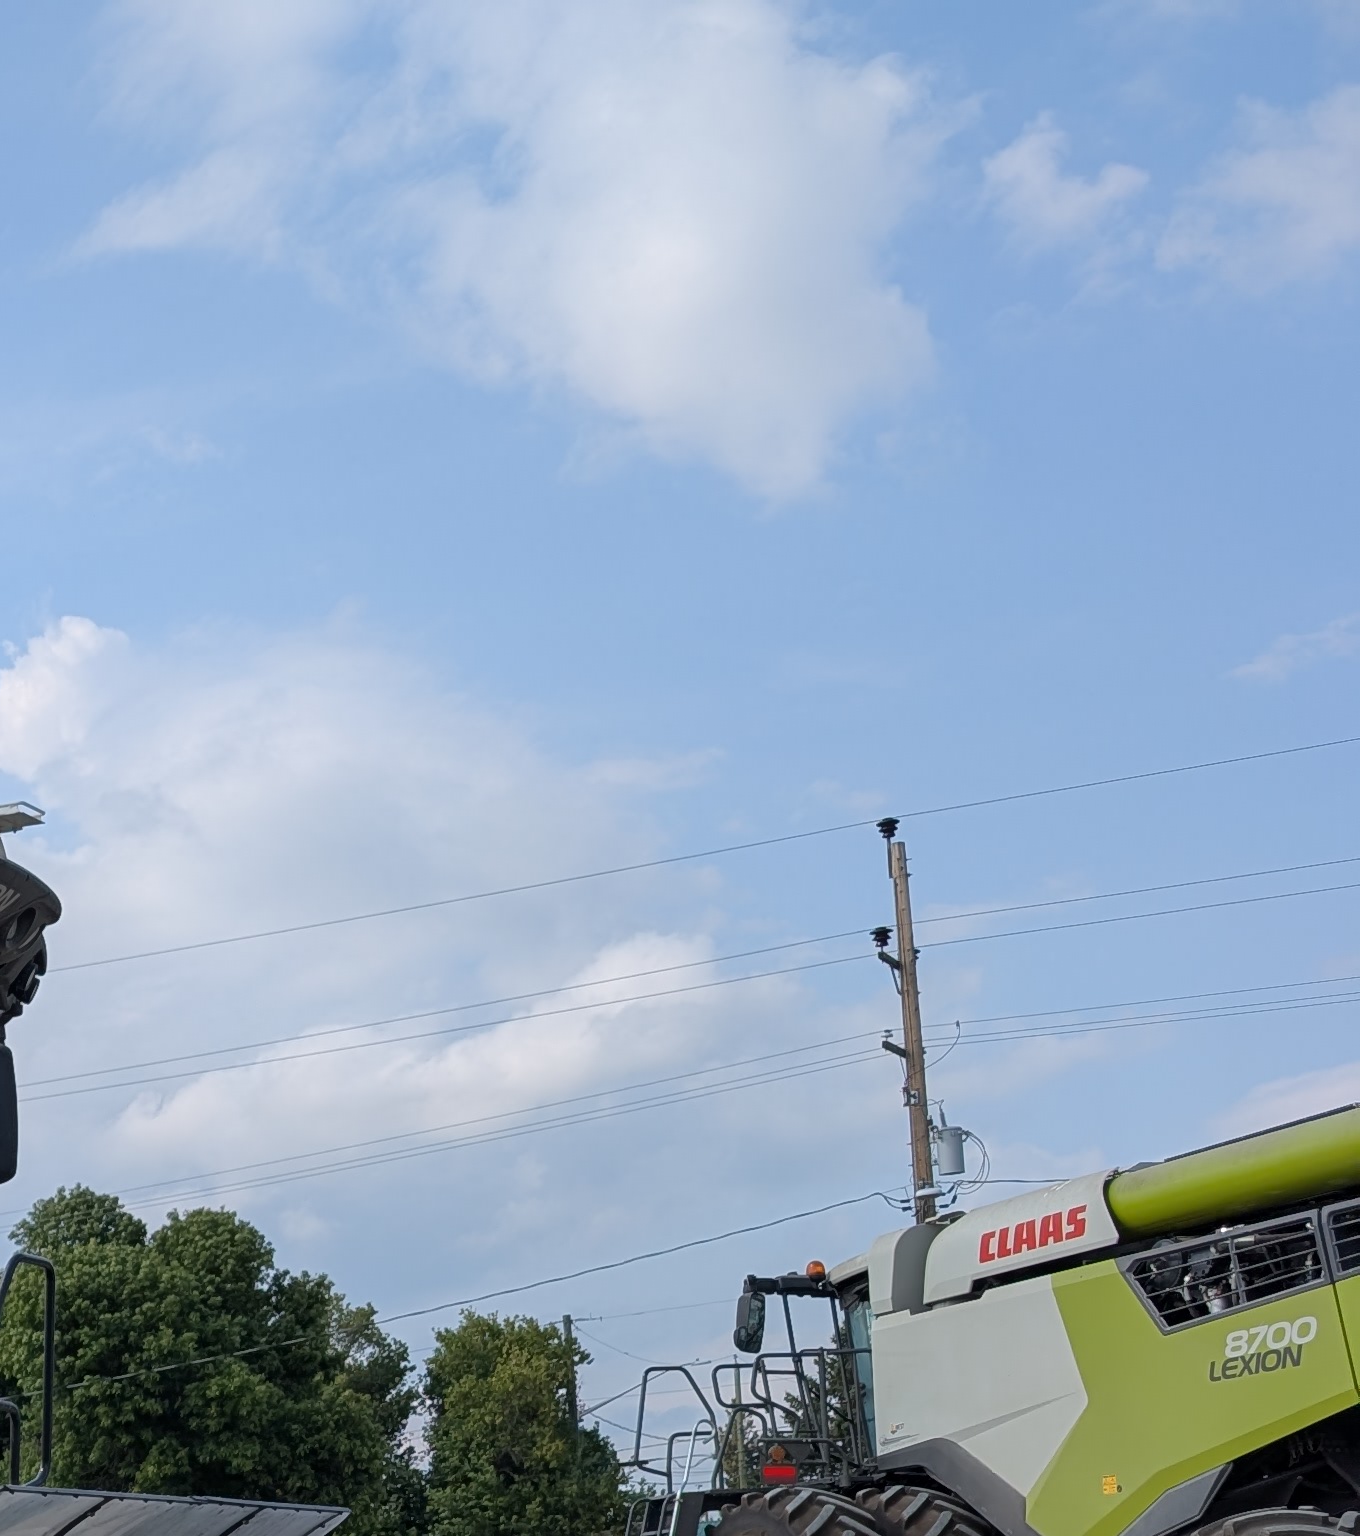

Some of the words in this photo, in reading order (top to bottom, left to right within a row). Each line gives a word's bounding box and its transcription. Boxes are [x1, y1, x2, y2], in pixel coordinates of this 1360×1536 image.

[978, 1204, 1087, 1264] CLAAS
[1225, 1316, 1317, 1358] 8700
[1209, 1344, 1303, 1382] LEXION
